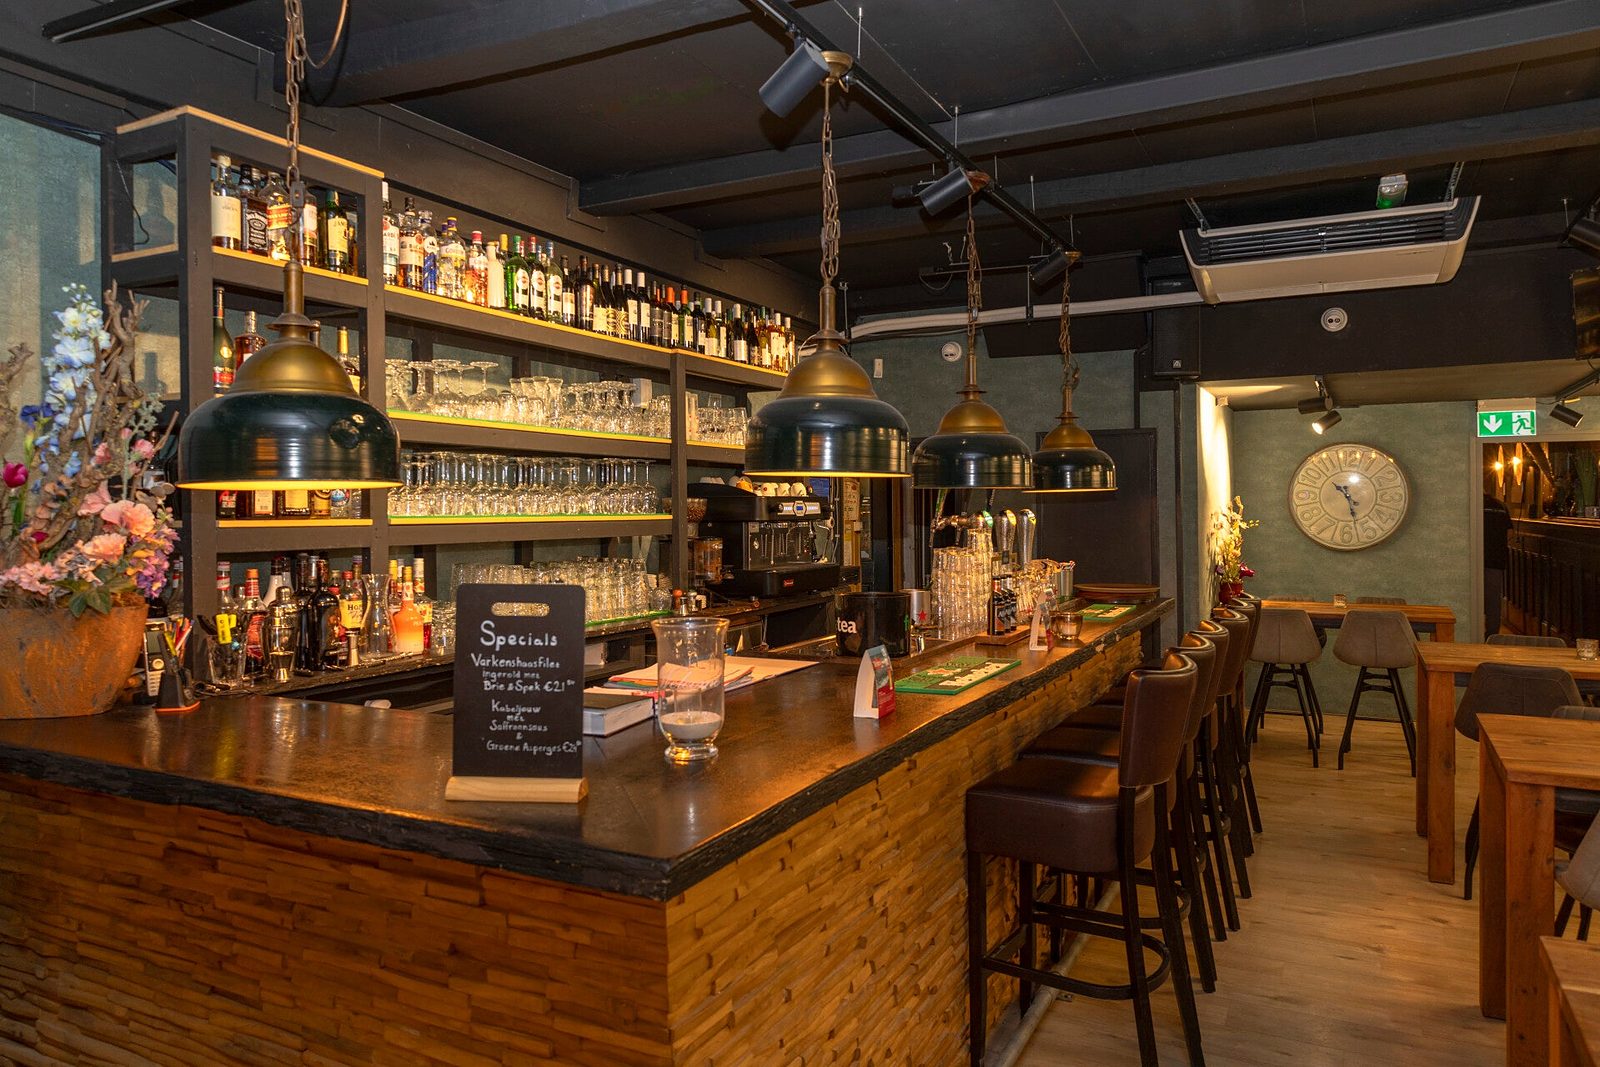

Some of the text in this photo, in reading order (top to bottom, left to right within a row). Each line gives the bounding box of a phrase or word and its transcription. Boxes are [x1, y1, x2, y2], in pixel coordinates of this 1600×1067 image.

[1341, 449, 1361, 467] 12
[1299, 467, 1322, 486] 10
[1376, 465, 1399, 487] 2
[1295, 490, 1318, 501] 9
[1378, 490, 1403, 503] 3
[1300, 506, 1322, 522] 8
[1375, 508, 1399, 526] 4
[1315, 518, 1336, 535] 7
[1340, 522, 1353, 544] 6
[1361, 520, 1377, 540] 5
[836, 616, 857, 634] tea
[480, 620, 558, 651] Specials
[483, 680, 505, 691] Brie
[514, 679, 541, 694] Spek
[486, 739, 521, 752] Groene
[522, 742, 561, 756] Asperges
